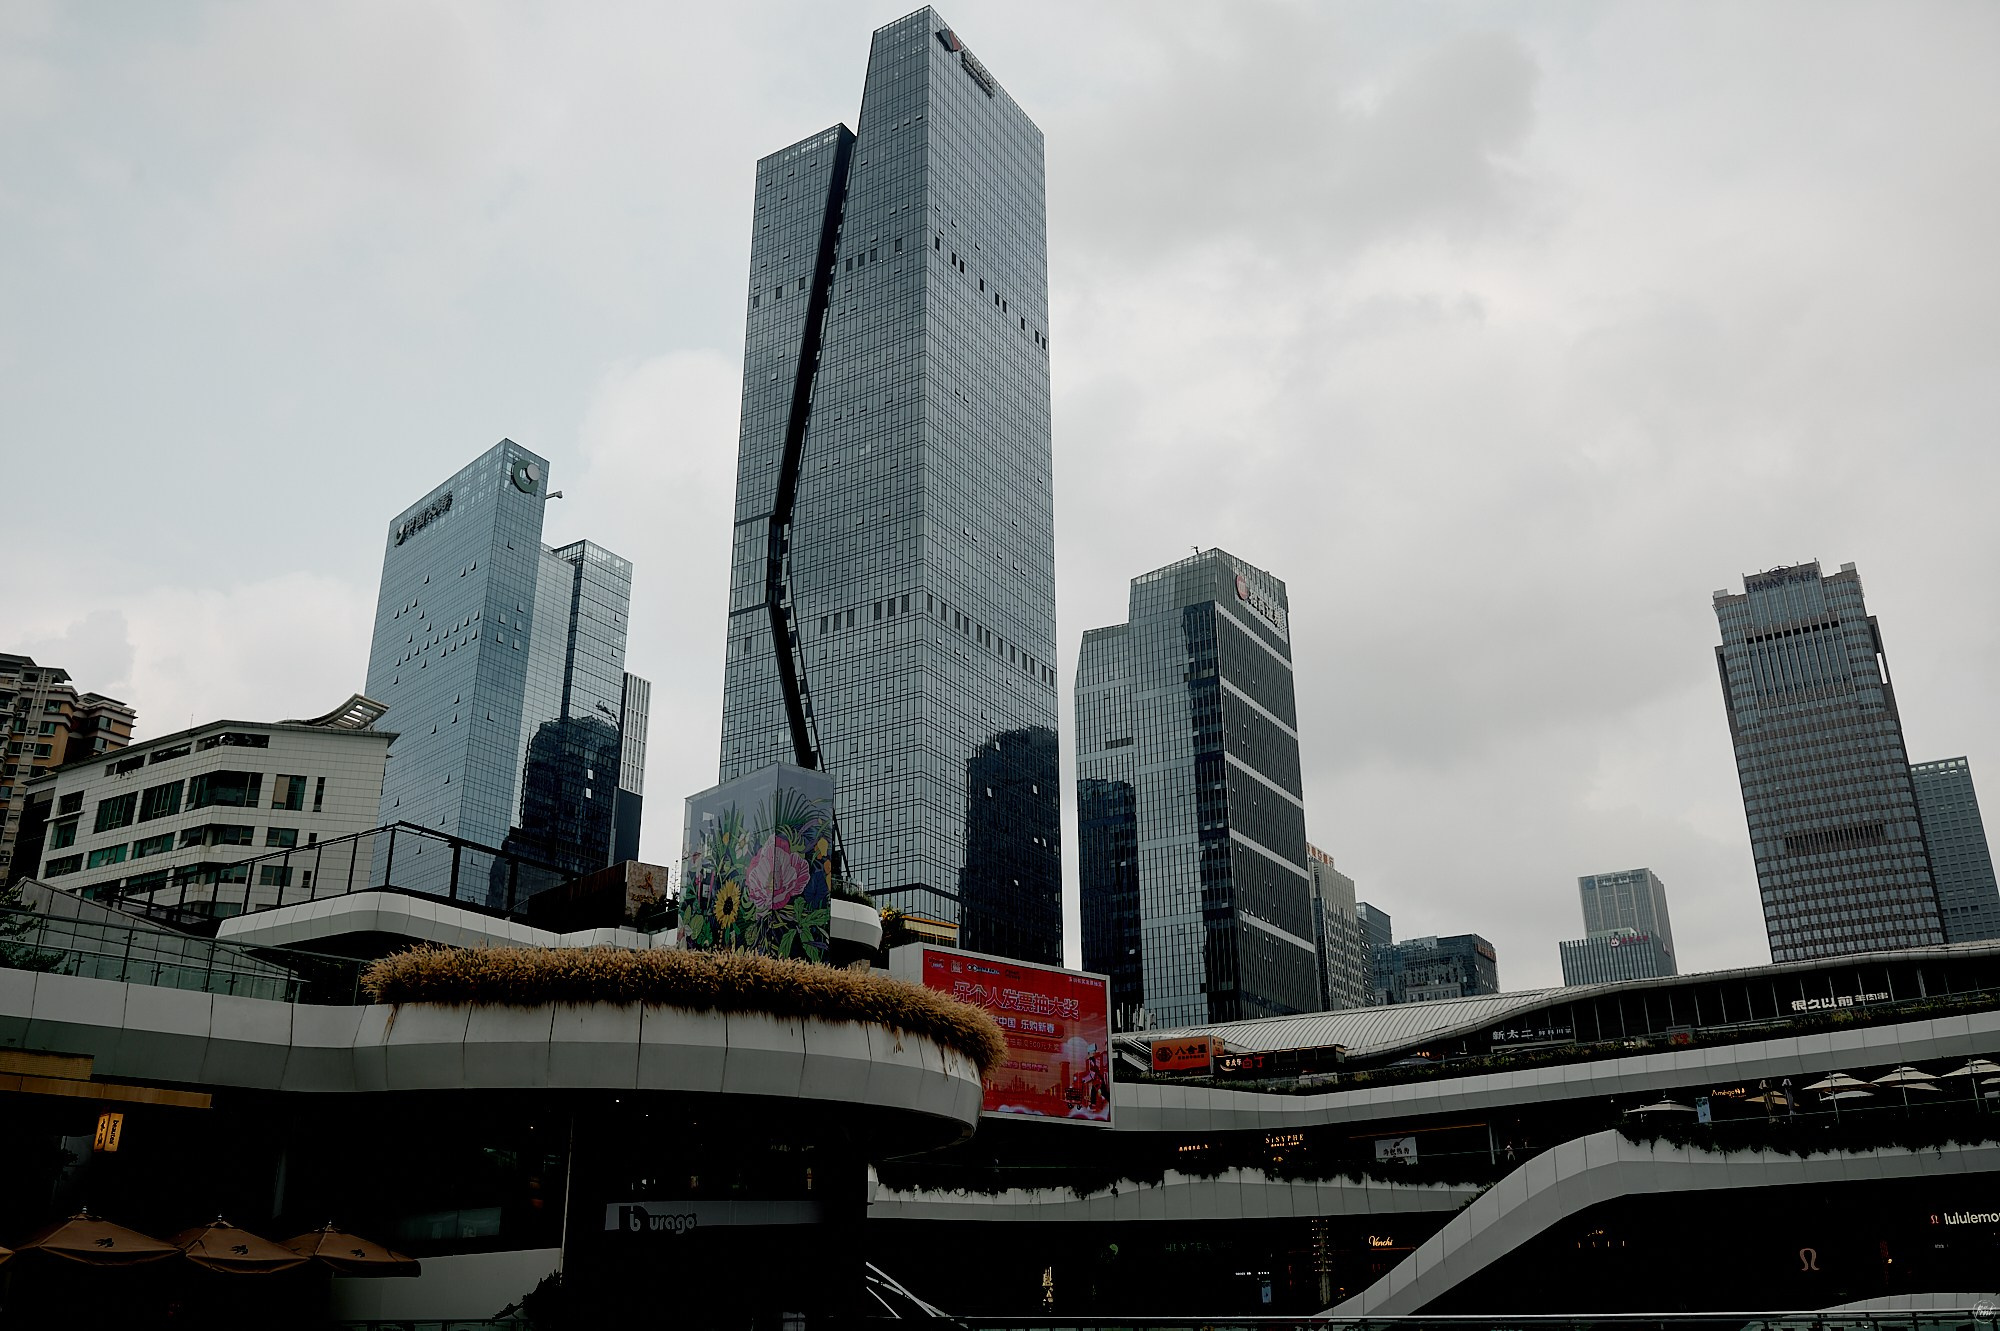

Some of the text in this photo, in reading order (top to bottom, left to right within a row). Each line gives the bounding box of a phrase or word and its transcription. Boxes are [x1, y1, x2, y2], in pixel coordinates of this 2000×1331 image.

[953, 981, 1079, 1020] 开个人发票抽大奖
[1791, 992, 1888, 1011] 很久以前 羊肉串
[1020, 1018, 1055, 1034] 乐购新春
[1265, 1133, 1304, 1144] SISYPHE
[1943, 1211, 2000, 1226] lululemo
